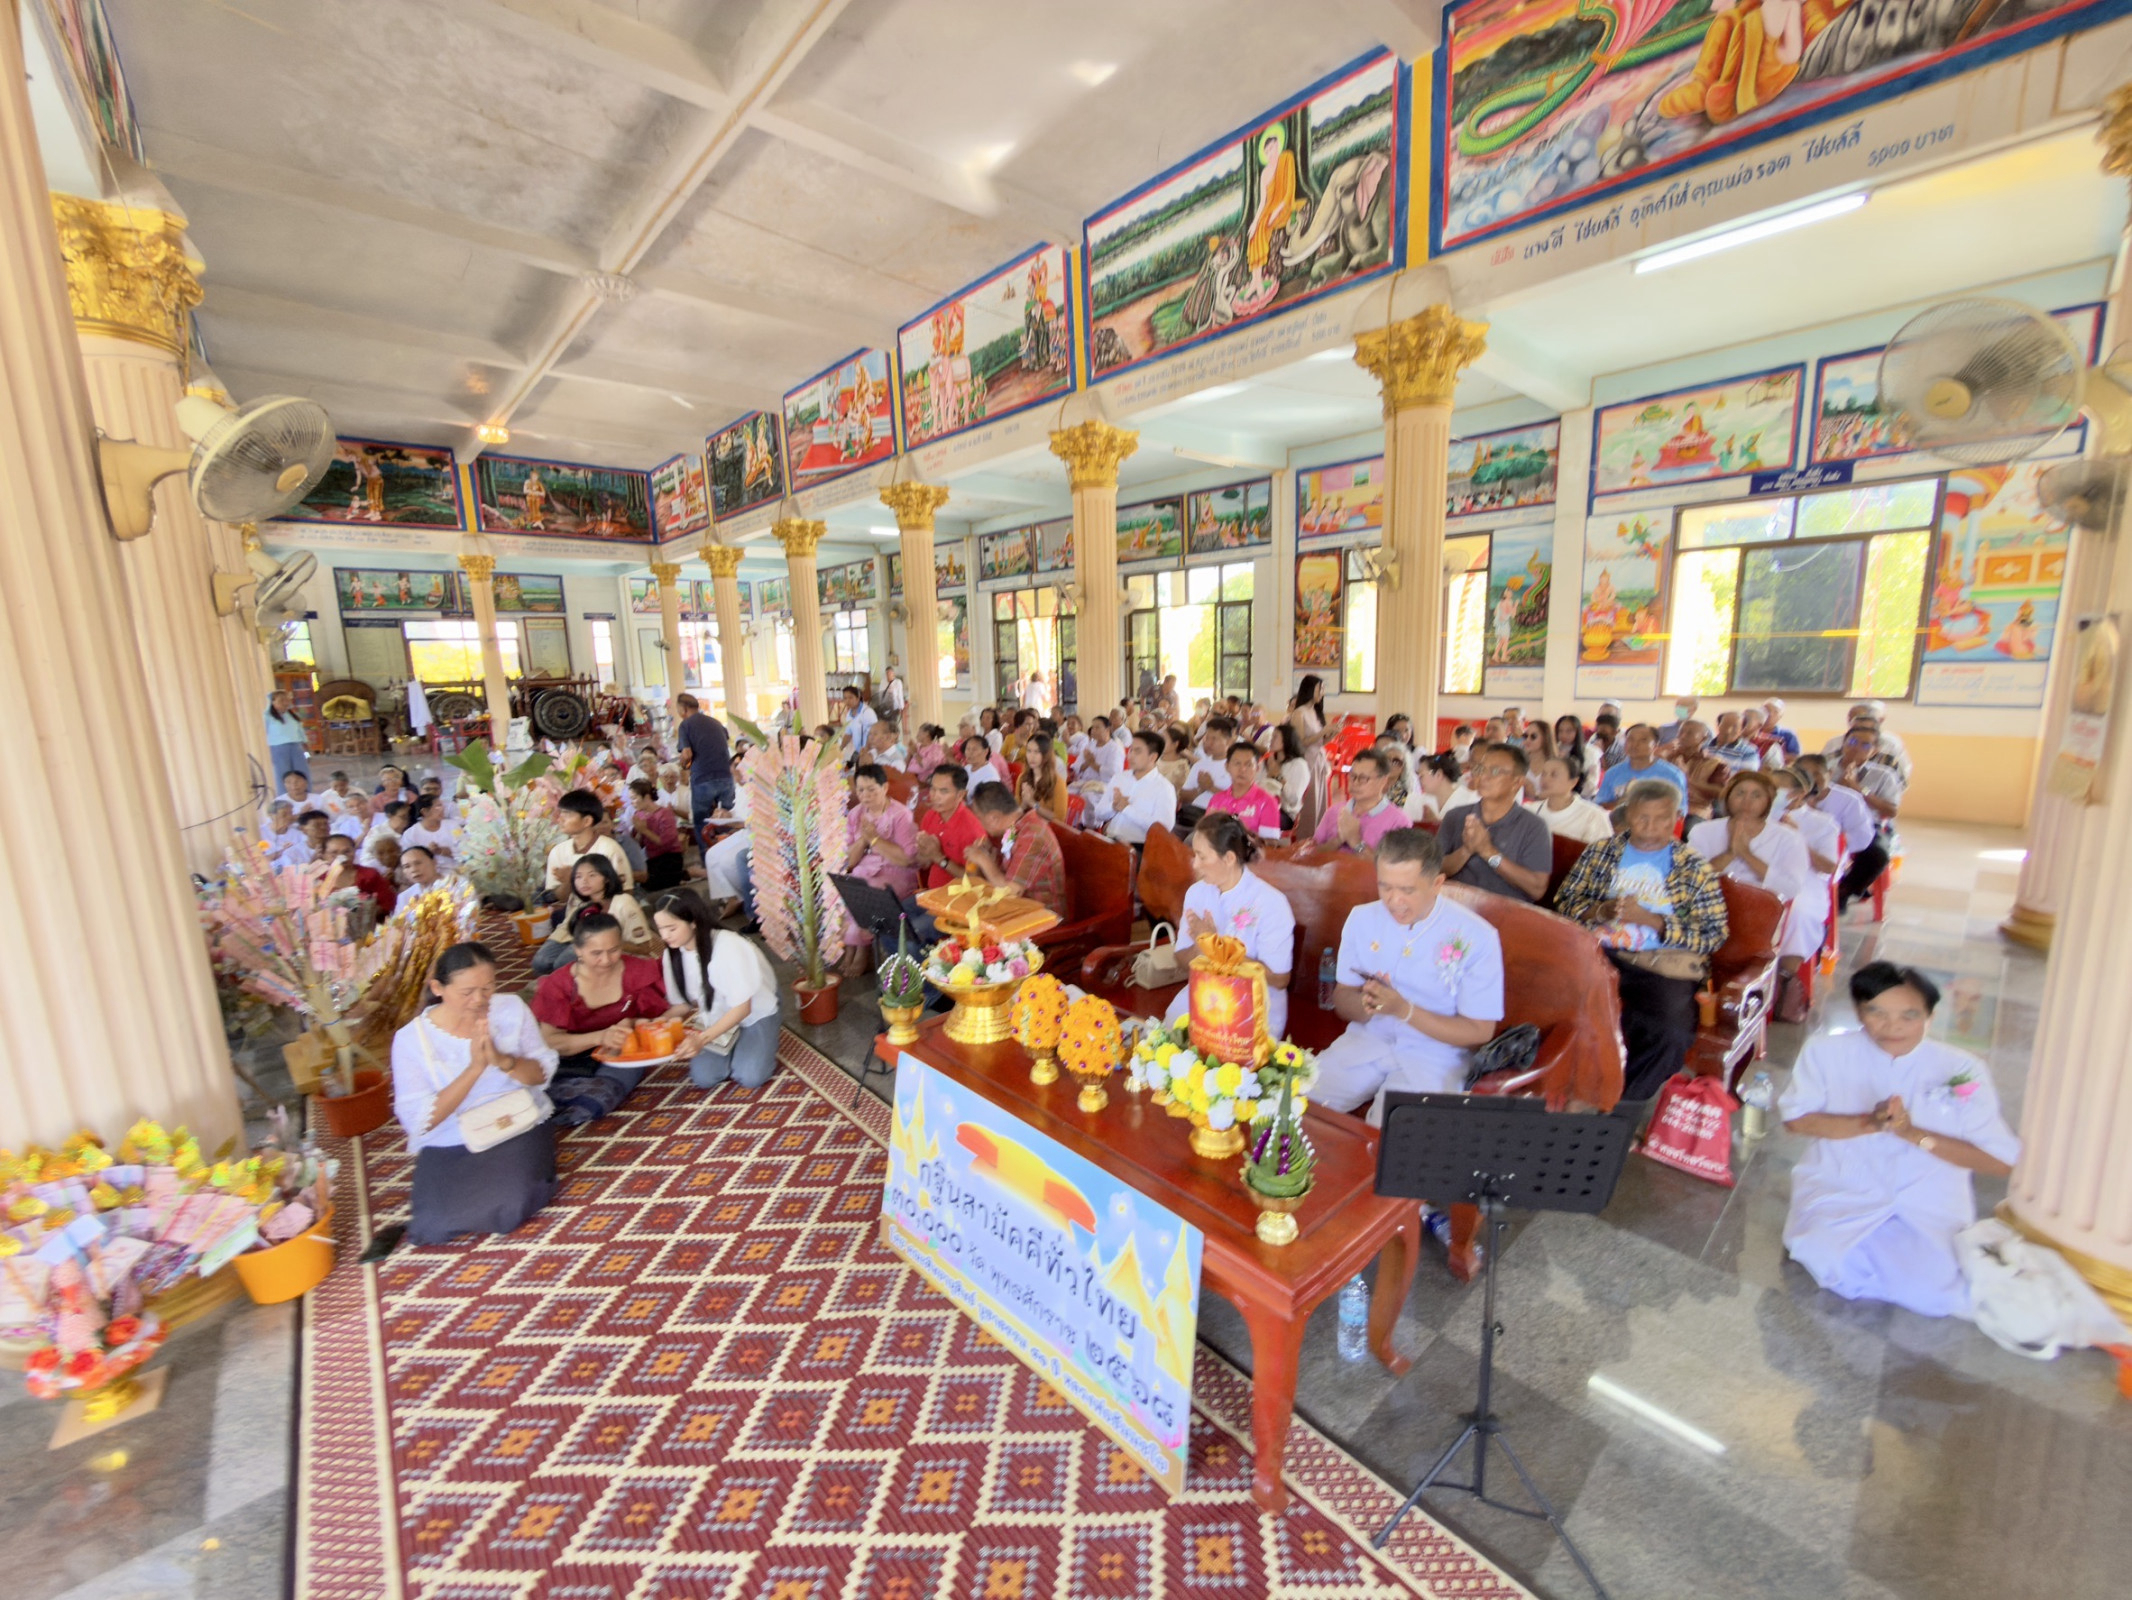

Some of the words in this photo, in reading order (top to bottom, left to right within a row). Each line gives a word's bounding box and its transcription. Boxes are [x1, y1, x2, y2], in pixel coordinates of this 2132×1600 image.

[920, 1160, 1136, 1340] กฐินสามัคคีทั่วไทย
[968, 1241, 985, 1273] วัด
[990, 1263, 1077, 1345] พุทธศักราช
